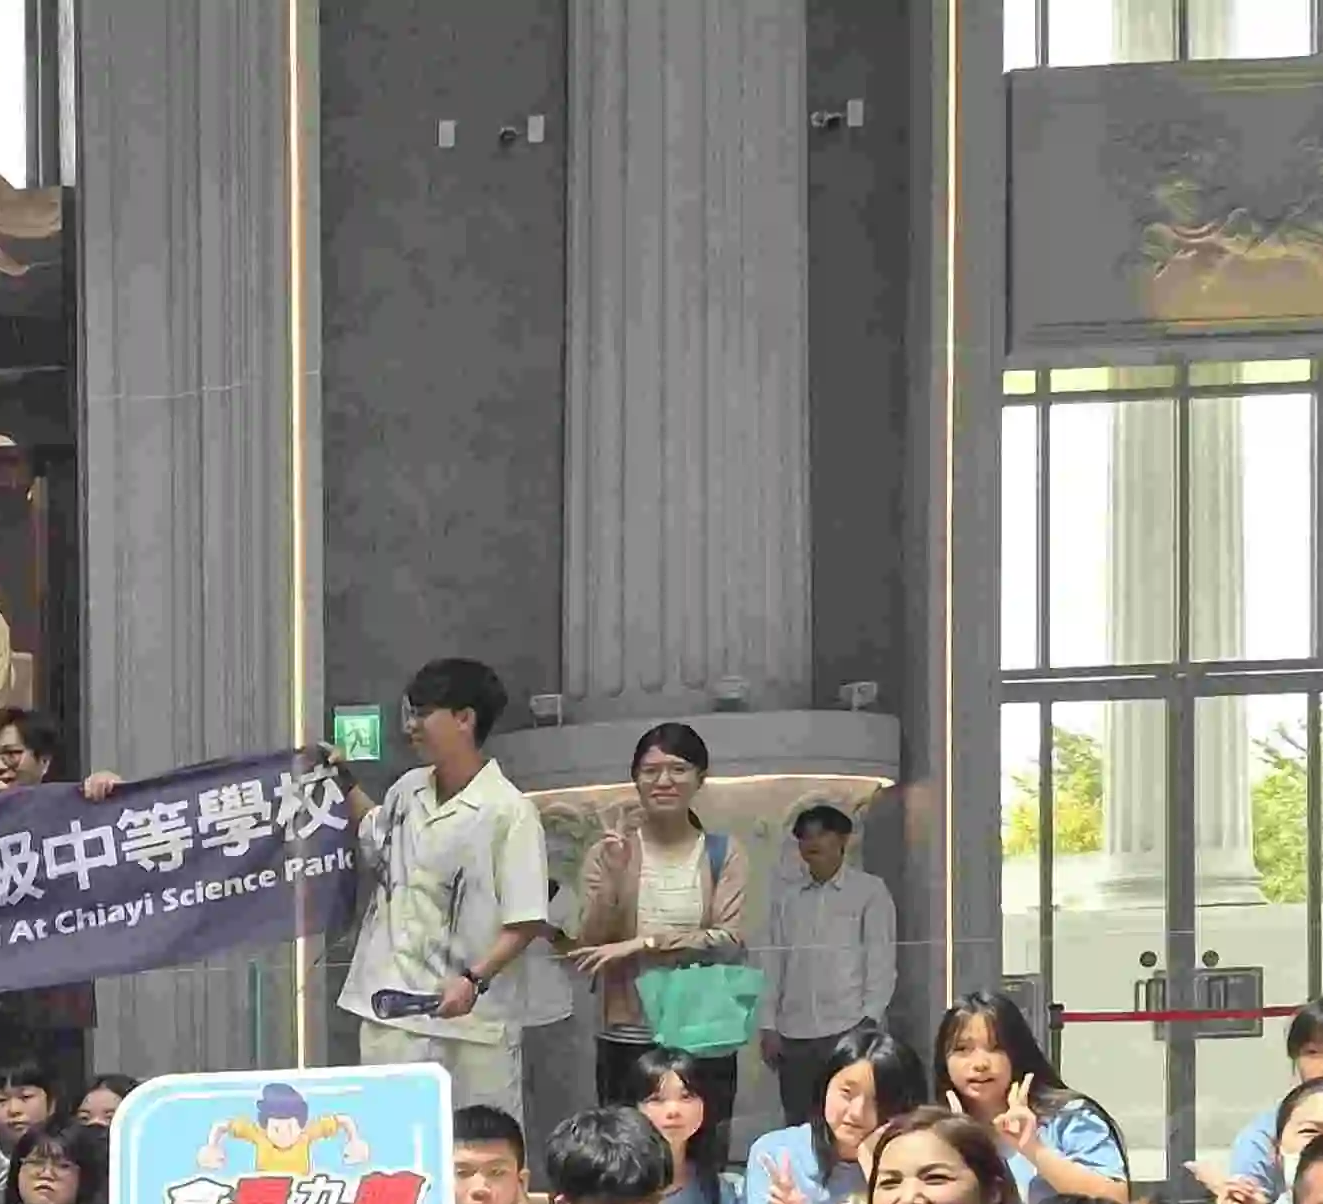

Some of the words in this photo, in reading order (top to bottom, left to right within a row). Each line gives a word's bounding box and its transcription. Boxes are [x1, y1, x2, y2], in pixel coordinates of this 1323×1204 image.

[10, 918, 47, 944] At
[55, 893, 154, 935] Chiayi
[162, 868, 276, 912] Science
[285, 847, 354, 881] Park
